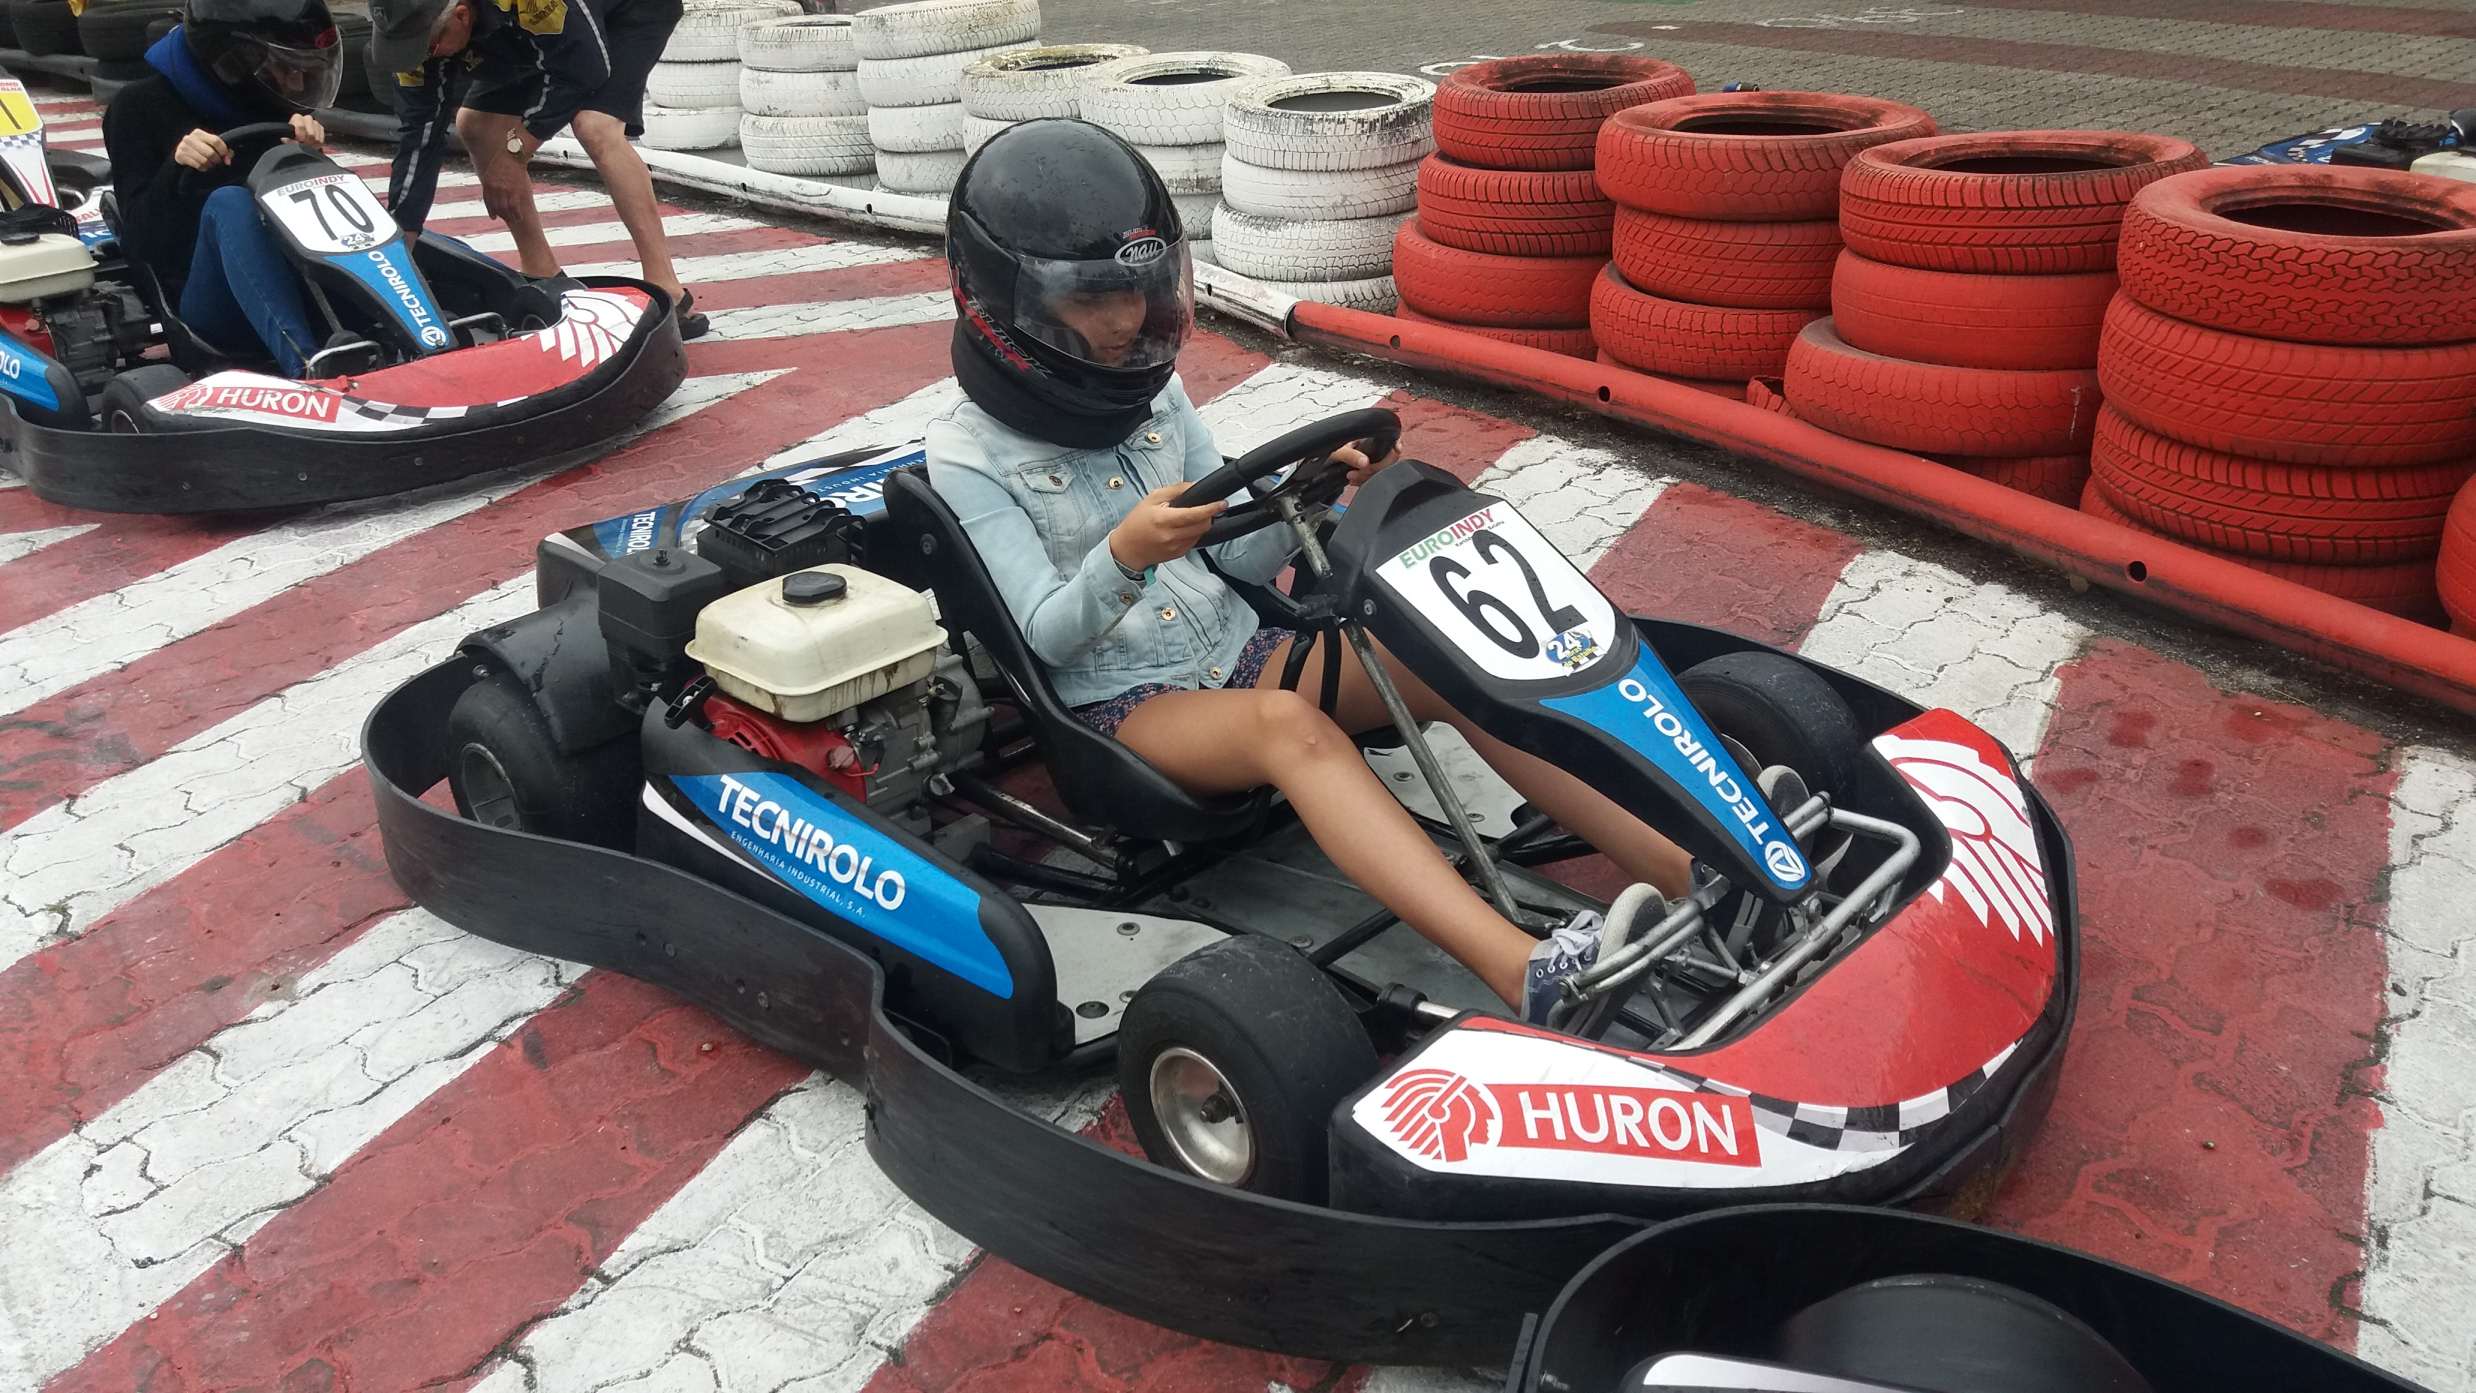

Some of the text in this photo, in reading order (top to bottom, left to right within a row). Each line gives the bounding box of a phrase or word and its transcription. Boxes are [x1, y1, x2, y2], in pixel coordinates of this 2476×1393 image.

[277, 175, 345, 197] EUROINDY
[289, 184, 374, 241] 70
[368, 250, 431, 327] TECNIROLO
[217, 388, 330, 418] HURON
[625, 511, 656, 556] TECNIROL
[1400, 508, 1494, 569] EUROINDY
[1429, 529, 1589, 659] 62
[1547, 631, 1583, 660] 24
[1618, 678, 1769, 845] TECNIROLO
[718, 774, 906, 911] TECNIROLO
[730, 831, 785, 871] ENGENHARIA
[1518, 1091, 1739, 1156] HURON
